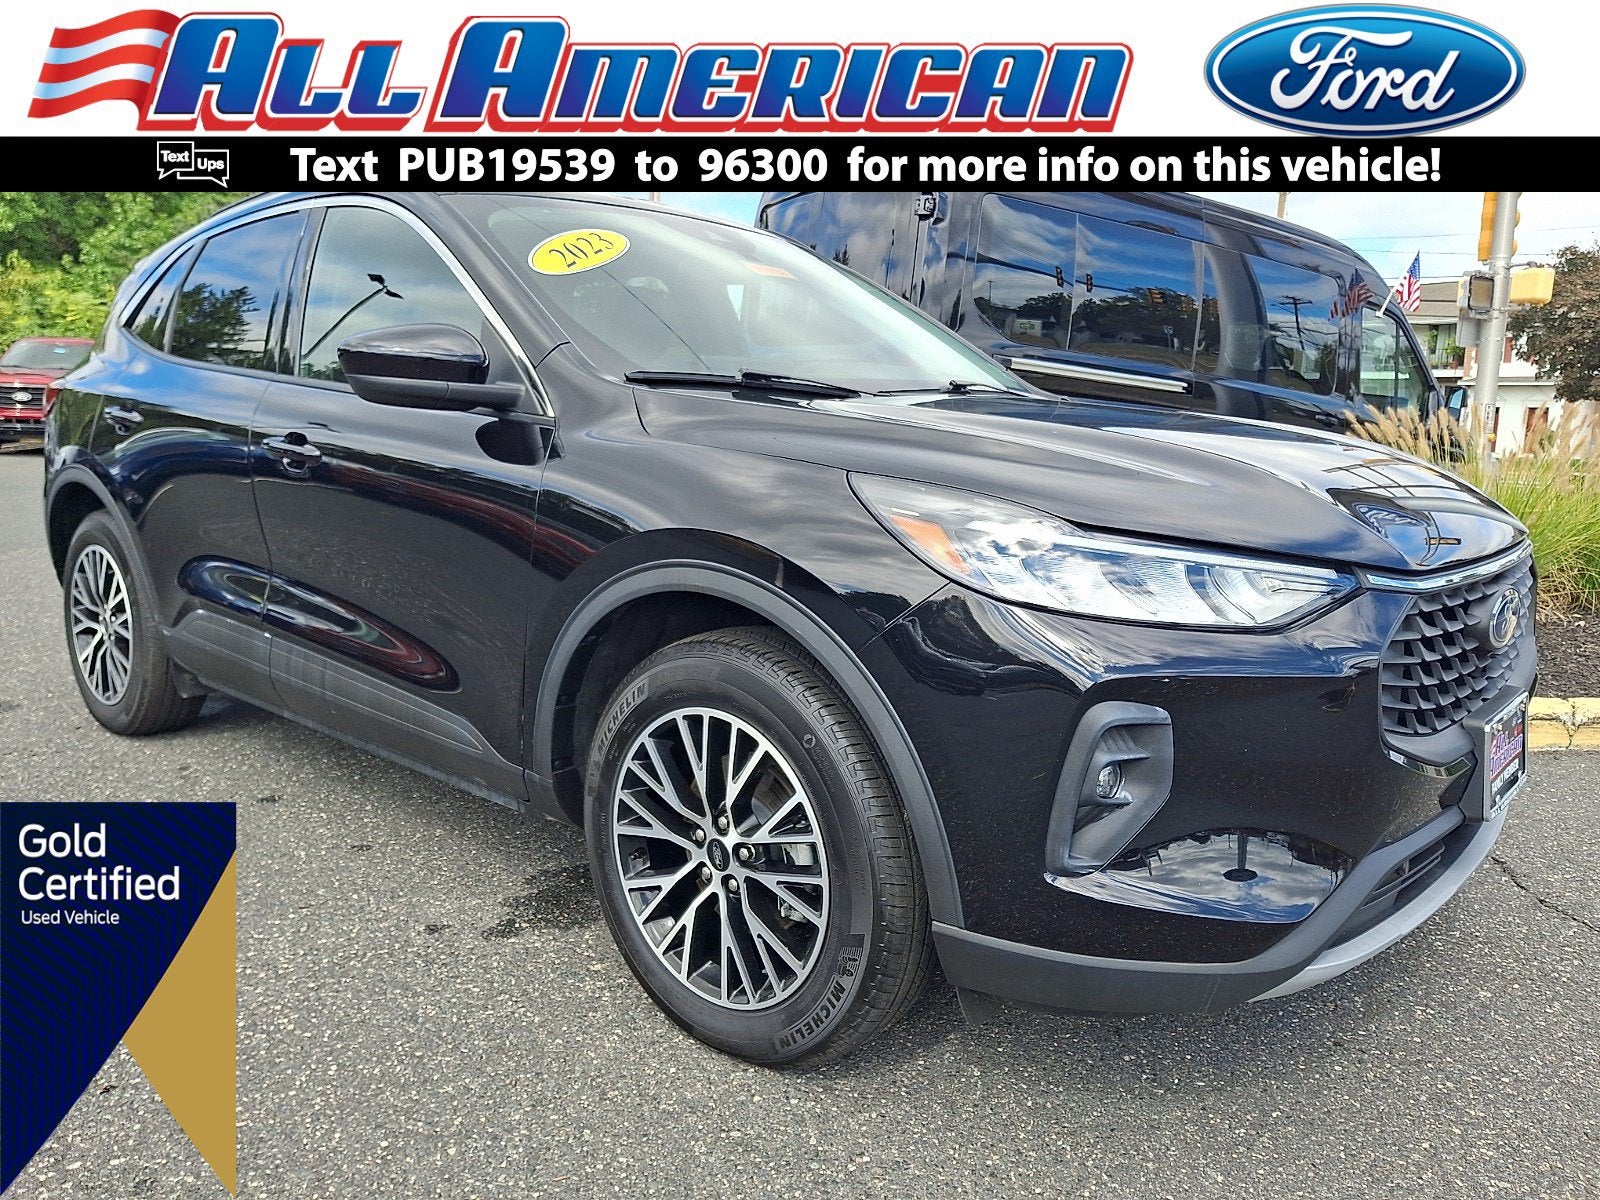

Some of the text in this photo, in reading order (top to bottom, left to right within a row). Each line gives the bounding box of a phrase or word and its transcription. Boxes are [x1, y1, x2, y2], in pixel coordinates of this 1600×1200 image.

[548, 232, 614, 268] 2023
[598, 681, 647, 754] MICHELIN
[780, 980, 846, 1049] MICHELIN
